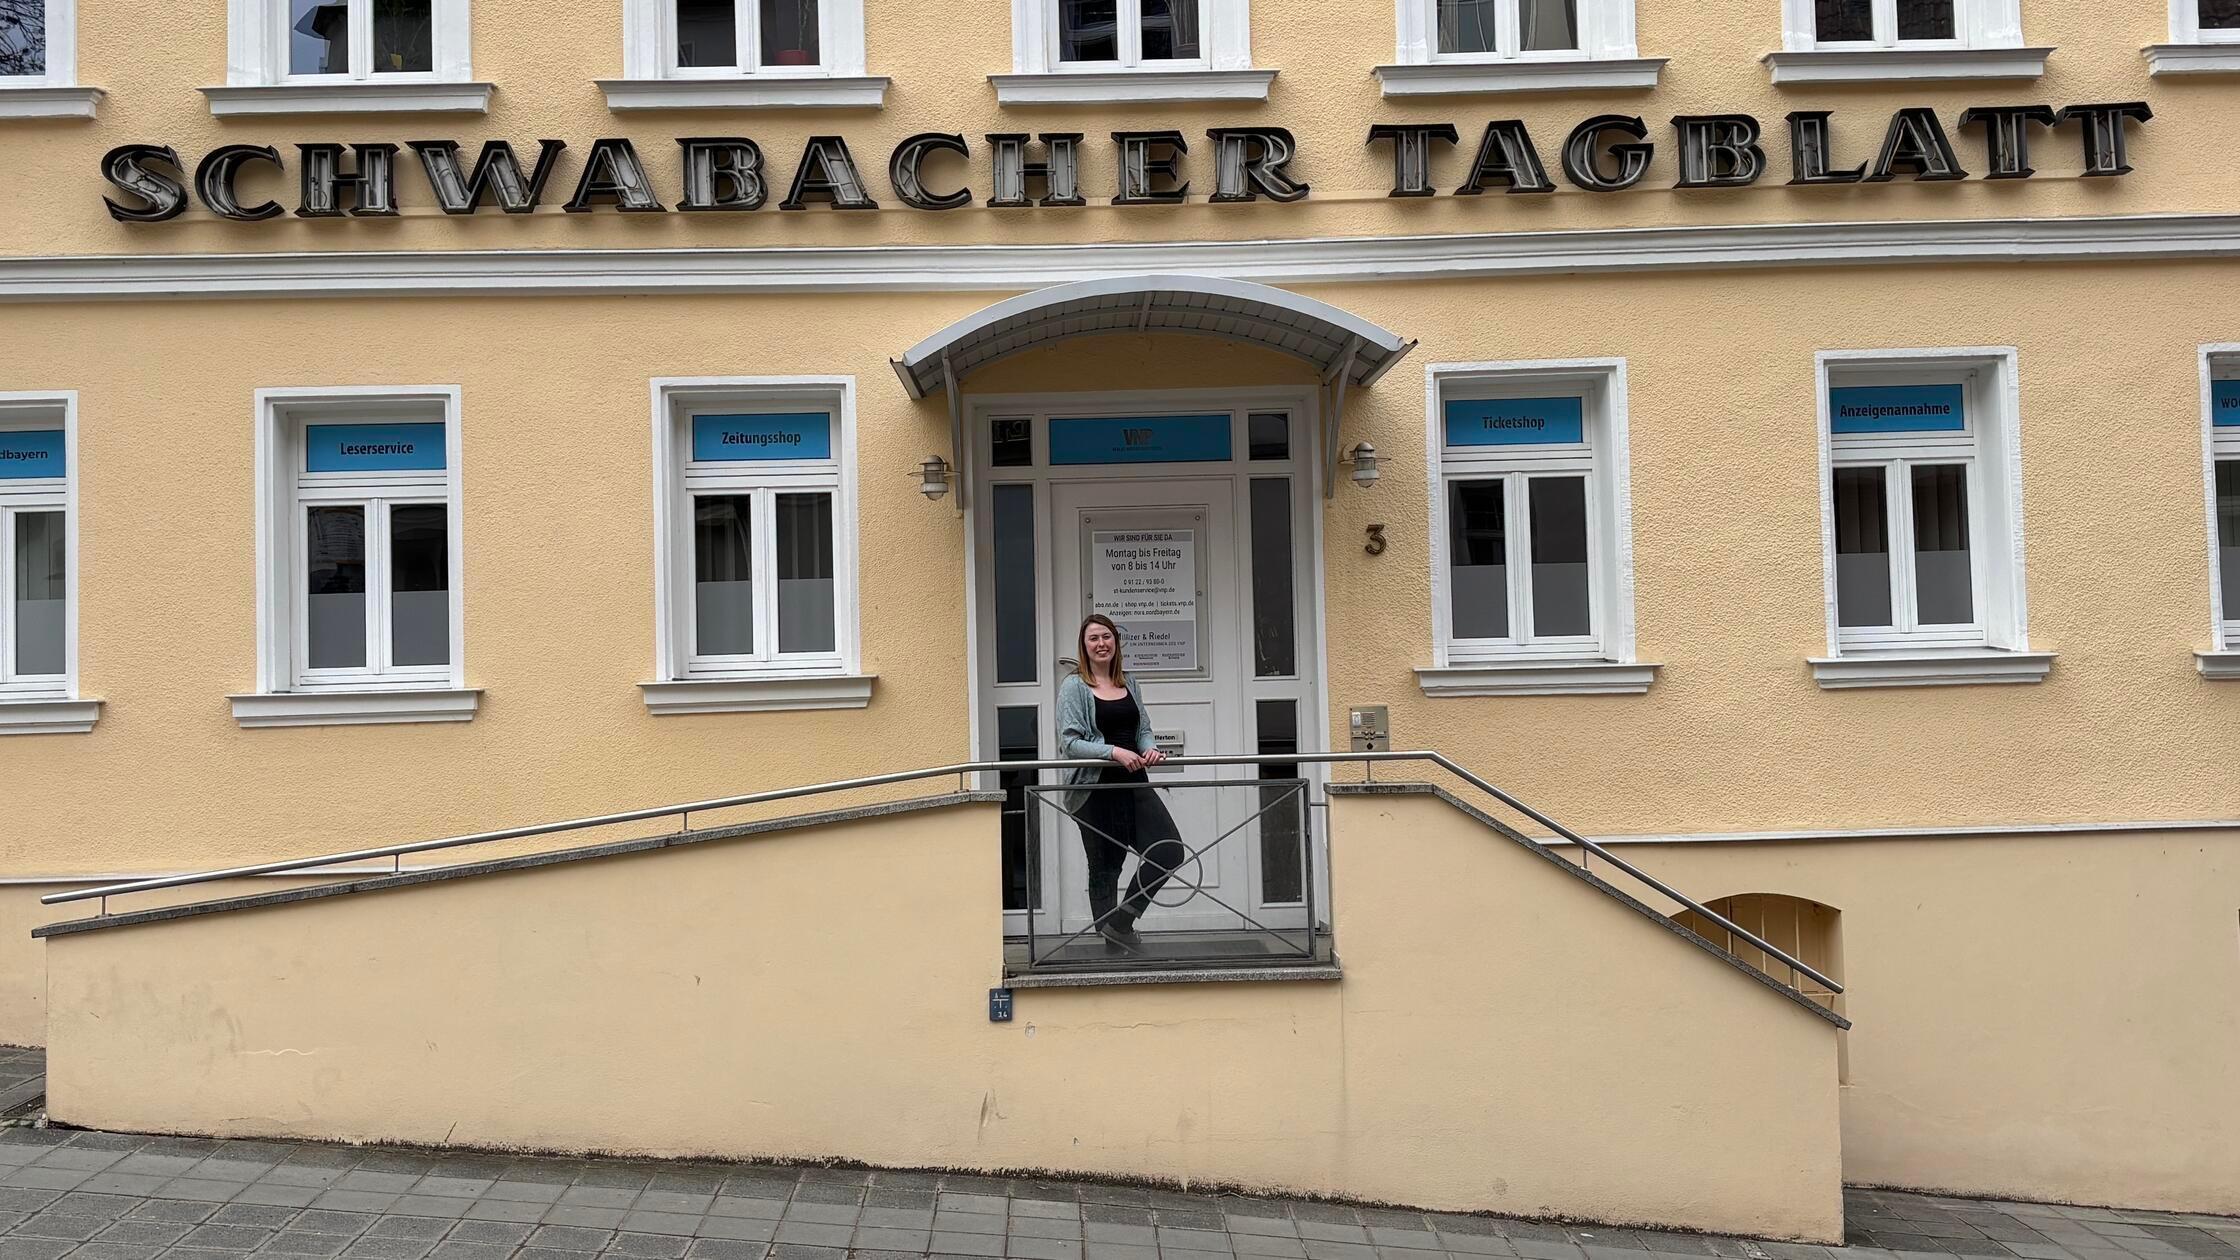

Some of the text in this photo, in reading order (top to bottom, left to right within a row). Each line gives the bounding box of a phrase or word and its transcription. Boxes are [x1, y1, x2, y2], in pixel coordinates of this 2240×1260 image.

[102, 102, 2153, 222] SCHWABACHER TAGBLATT
[2221, 397, 2240, 408] wo
[1840, 402, 1950, 419] Anzeigenannahme
[1482, 415, 1545, 430] Ticketshop
[721, 430, 801, 446] Zeitungsshop
[340, 441, 414, 455] Leserservice
[1113, 534, 1125, 542] WIR
[1141, 533, 1153, 541] FÜR
[1153, 533, 1163, 541] SIE
[1164, 533, 1173, 541] DA
[1365, 524, 1386, 554] 3
[1105, 547, 1181, 559] Montag bis Freitag
[1111, 560, 1176, 571] von 8 bis 14 Uhr
[1149, 631, 1171, 640] Riedel
